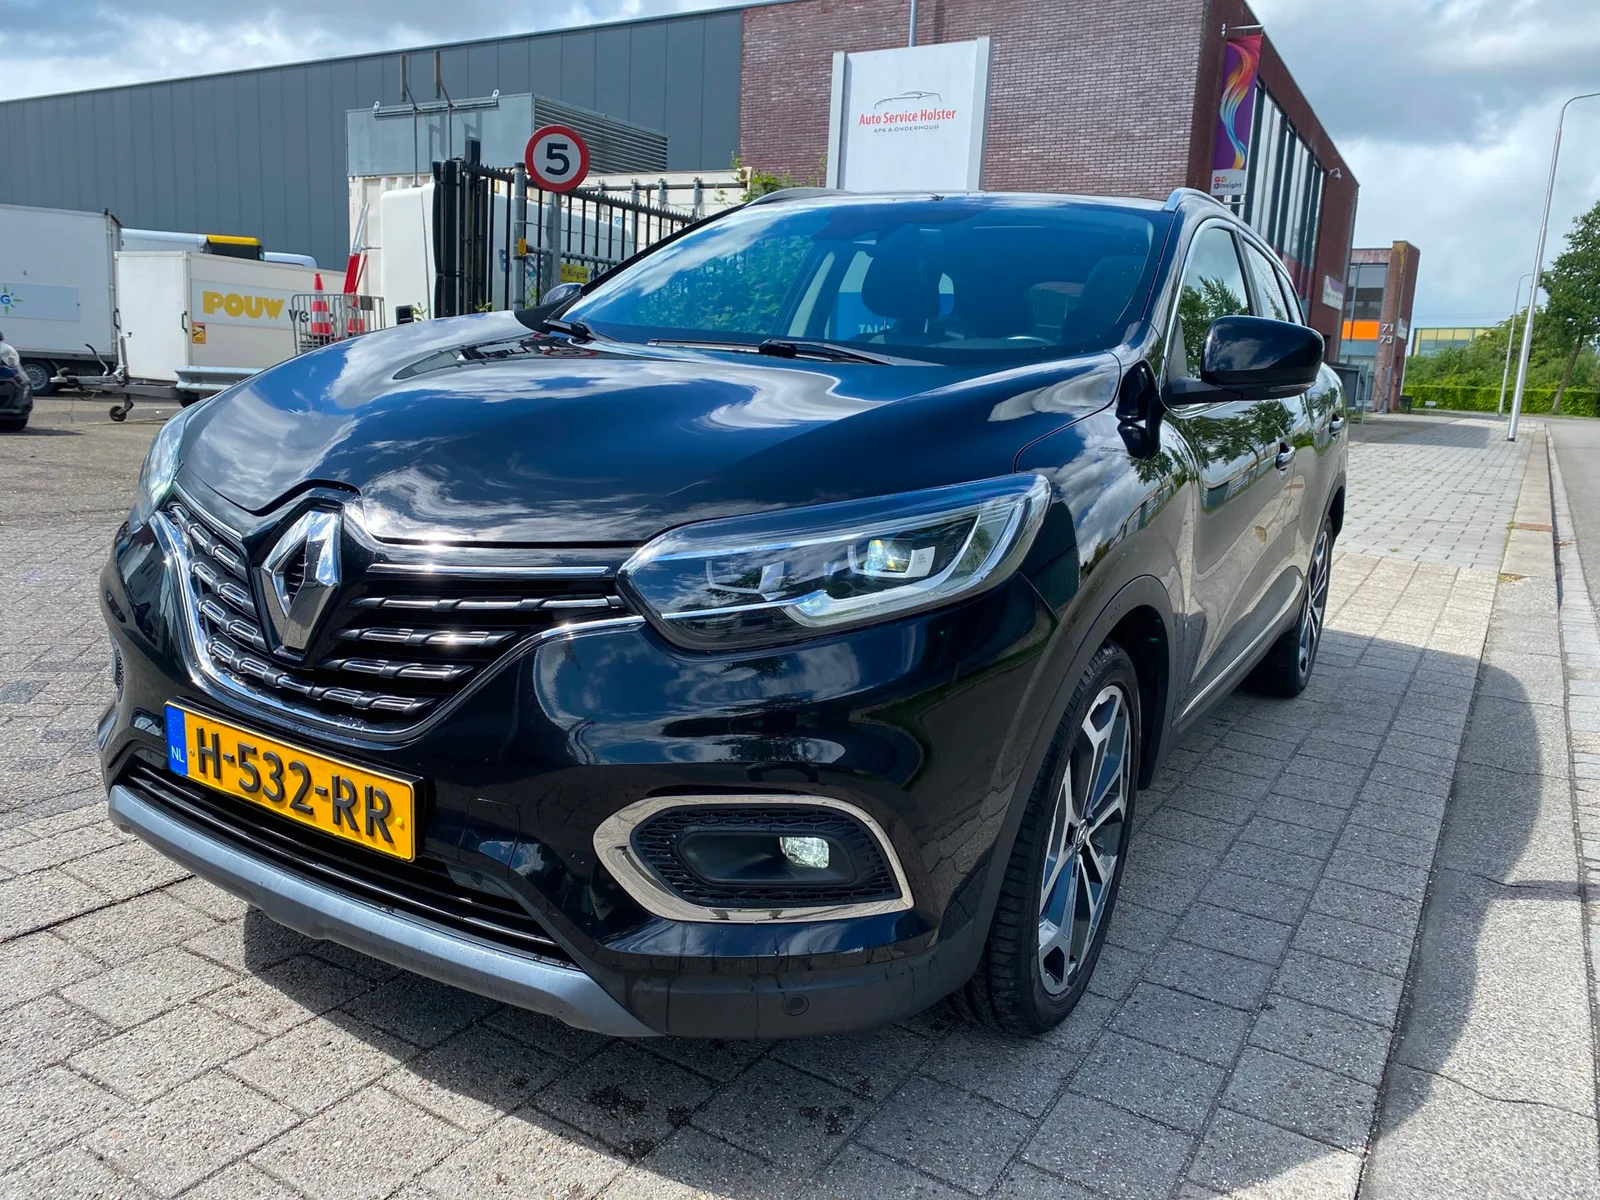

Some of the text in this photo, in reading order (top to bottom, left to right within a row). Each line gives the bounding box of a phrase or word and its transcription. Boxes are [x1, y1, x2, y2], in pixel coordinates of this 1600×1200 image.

[859, 108, 956, 125] Auto Service Holster
[894, 124, 940, 132] ONDERHOUD
[545, 142, 570, 175] 5
[202, 291, 285, 321] POUW
[1381, 323, 1394, 333] 71
[1380, 335, 1394, 344] 73
[171, 745, 185, 763] NL
[196, 727, 394, 843] H-532-RR
